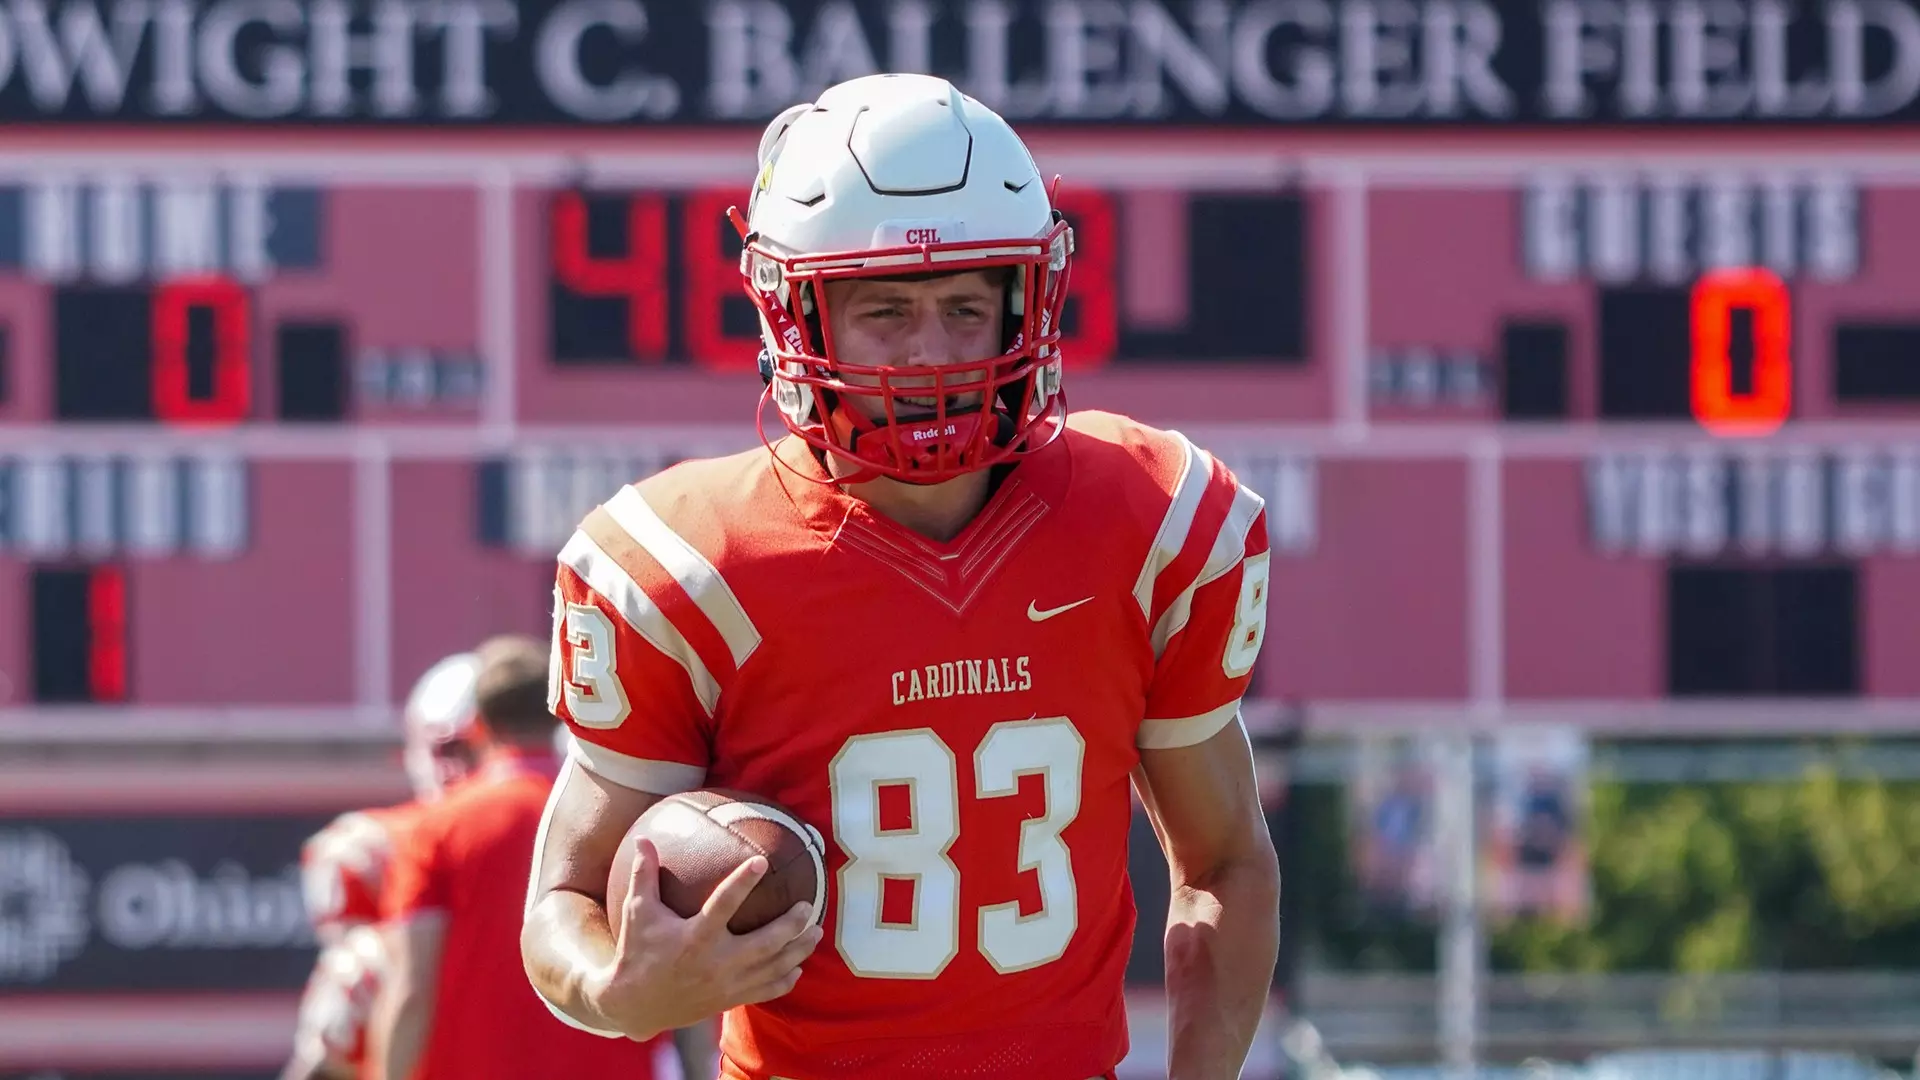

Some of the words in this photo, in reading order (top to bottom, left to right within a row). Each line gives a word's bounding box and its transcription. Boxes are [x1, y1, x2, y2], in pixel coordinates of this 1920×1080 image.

[0, 0, 518, 118] WIGHT
[535, 0, 680, 120] C.
[705, 0, 1514, 120] BALLENGER
[1545, 0, 1920, 118] FIELD
[906, 228, 941, 244] CHL
[150, 272, 251, 430] 0
[1690, 267, 1792, 436] 0
[547, 580, 632, 730] 3
[892, 656, 1032, 706] CARDINALS
[1222, 548, 1270, 679] 8
[829, 716, 1086, 980] 83
